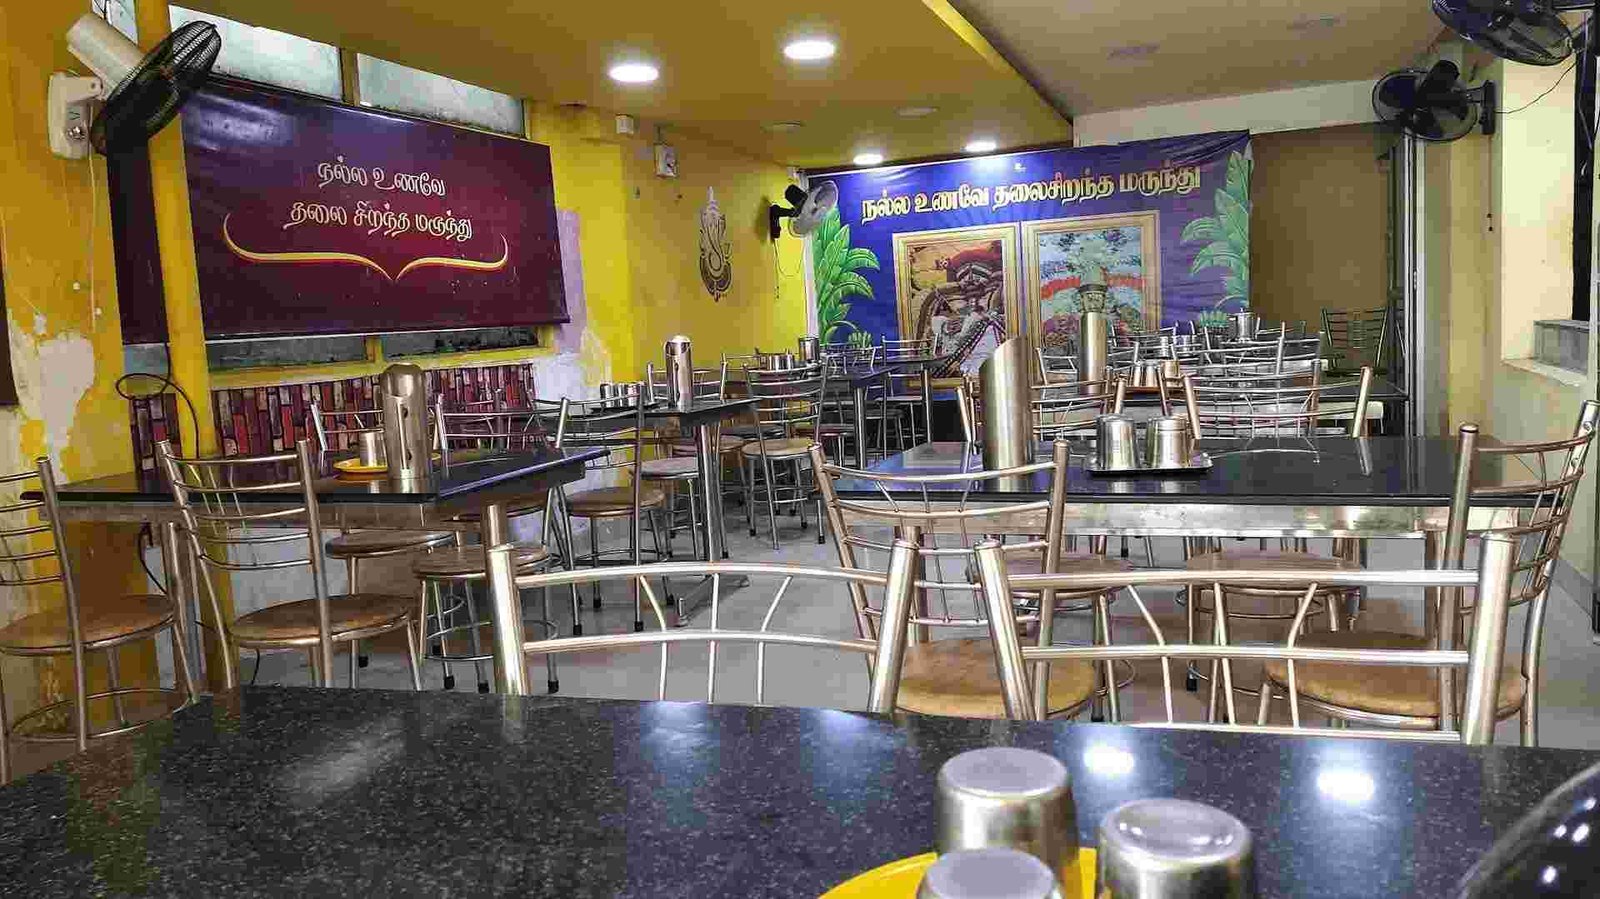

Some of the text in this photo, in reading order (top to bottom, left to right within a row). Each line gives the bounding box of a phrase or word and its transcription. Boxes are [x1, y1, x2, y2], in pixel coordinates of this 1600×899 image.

[318, 154, 447, 197] நல்ல உணவே
[861, 187, 911, 225] நல்ல
[914, 183, 990, 214] உணவே
[1119, 159, 1201, 196] மருந்து
[283, 200, 472, 242] தலை சிறந்த மருந்து
